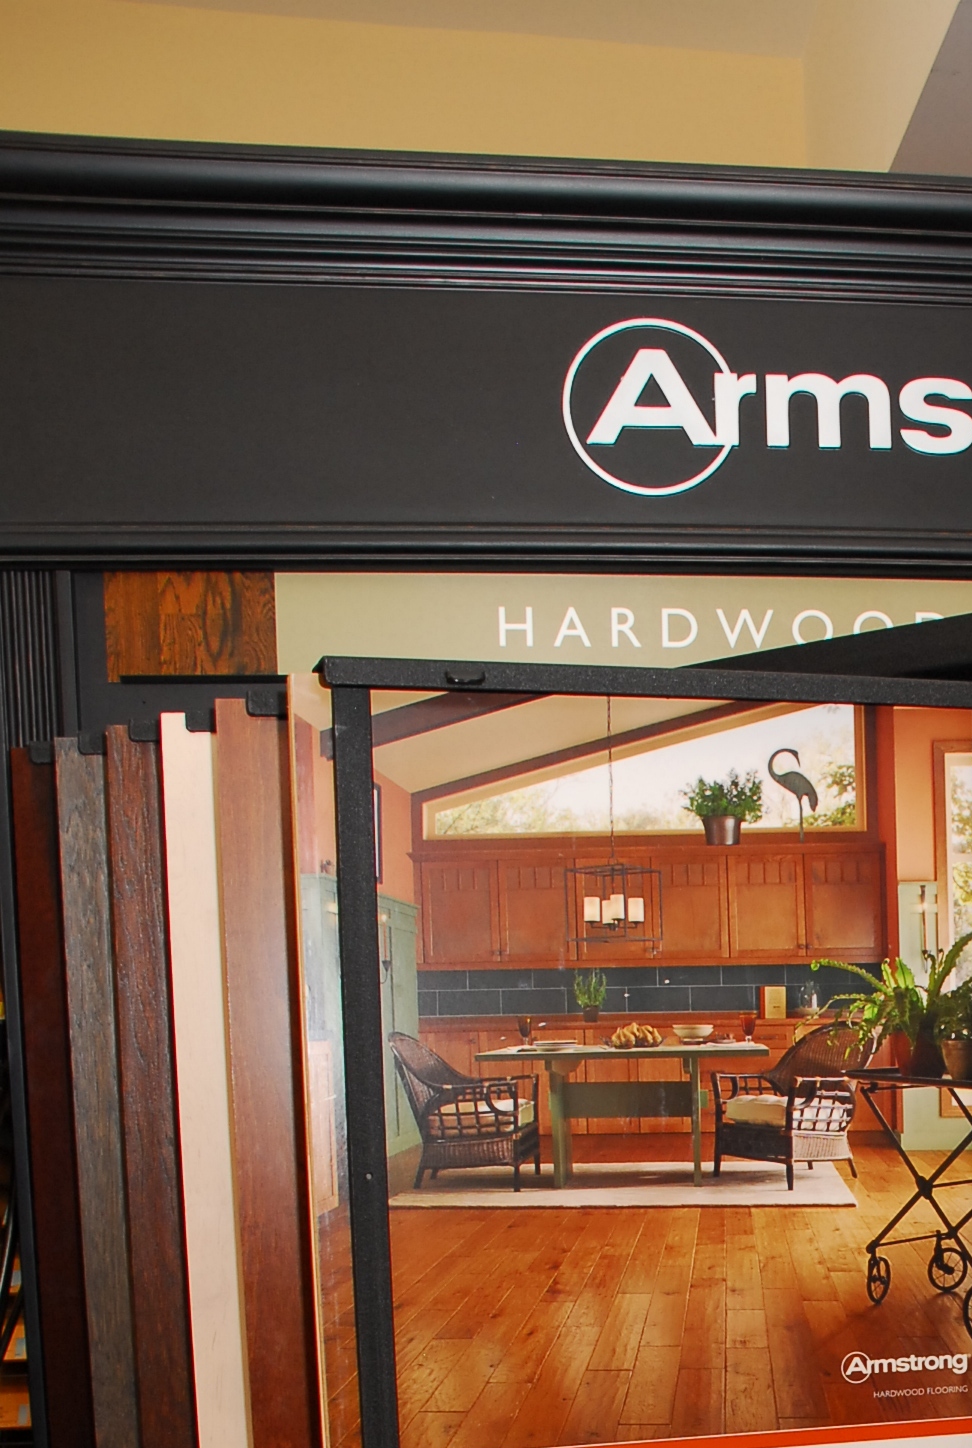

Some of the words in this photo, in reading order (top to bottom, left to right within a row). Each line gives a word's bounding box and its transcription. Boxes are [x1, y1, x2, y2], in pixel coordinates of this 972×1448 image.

[498, 608, 945, 651] HARDWO
[841, 1351, 967, 1384] Armstrong
[873, 1388, 925, 1398] HARDWOOD
[926, 1385, 968, 1395] FLOORING
